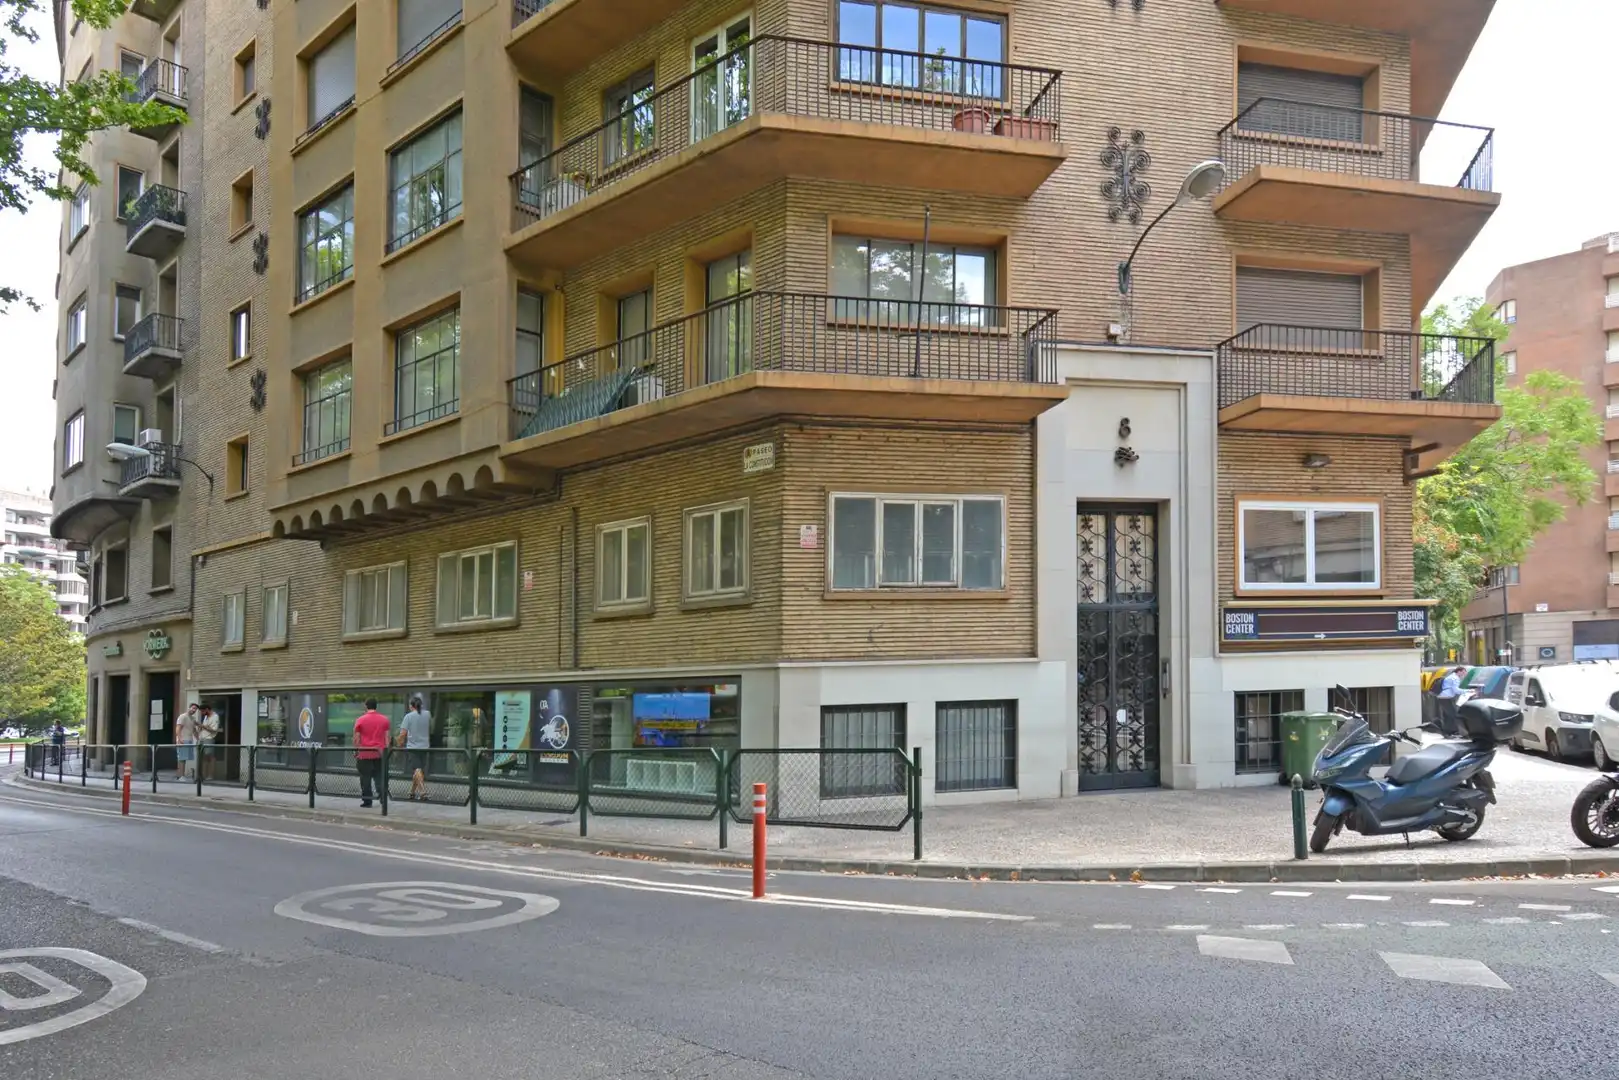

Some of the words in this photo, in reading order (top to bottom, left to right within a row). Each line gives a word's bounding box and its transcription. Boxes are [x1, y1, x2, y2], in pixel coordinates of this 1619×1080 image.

[1225, 613, 1254, 623] BOSTON
[1398, 610, 1424, 620] BOSTON
[1225, 623, 1254, 634] CENTER
[1398, 620, 1424, 631] CENTER
[320, 888, 503, 922] 30
